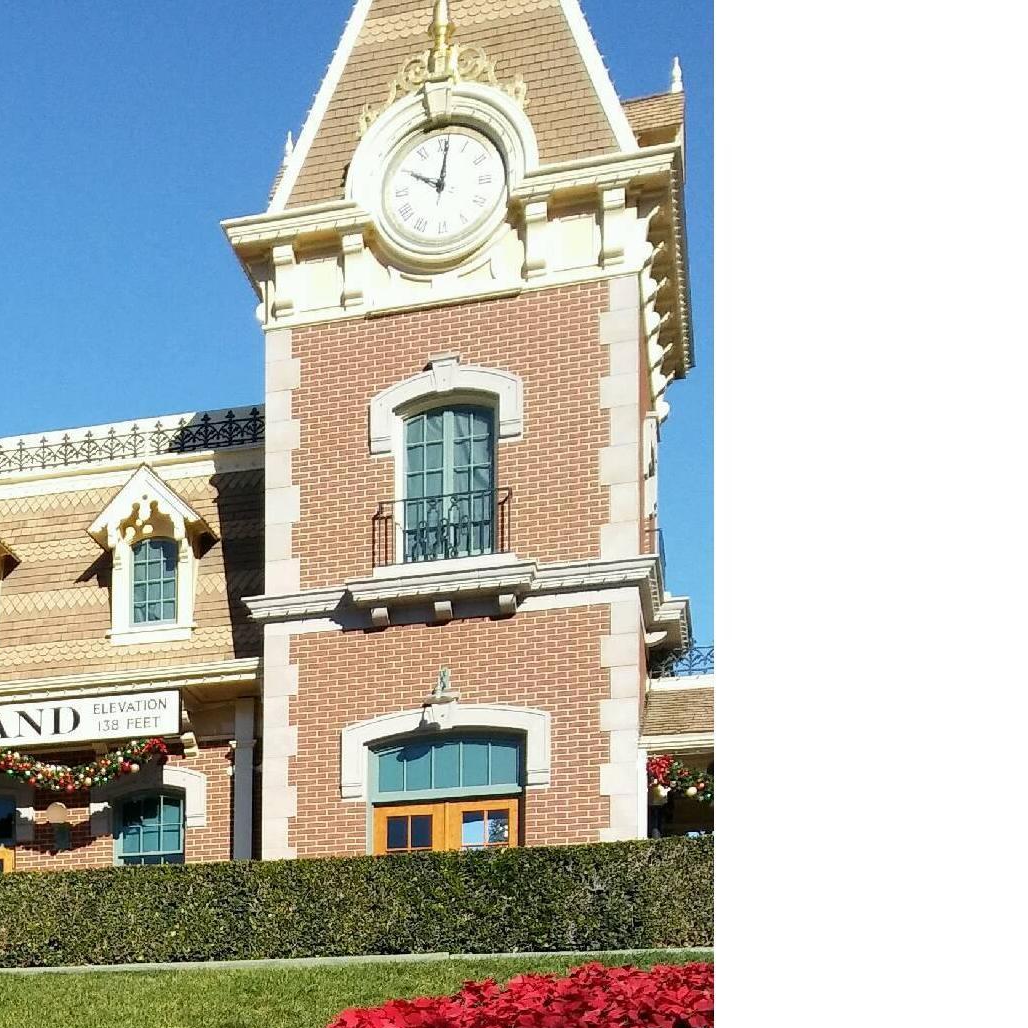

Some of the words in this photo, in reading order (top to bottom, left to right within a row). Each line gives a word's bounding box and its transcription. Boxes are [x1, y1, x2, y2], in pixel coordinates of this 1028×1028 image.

[93, 697, 167, 715] ELEVATION
[98, 719, 119, 732] 138
[126, 716, 161, 730] FEET
